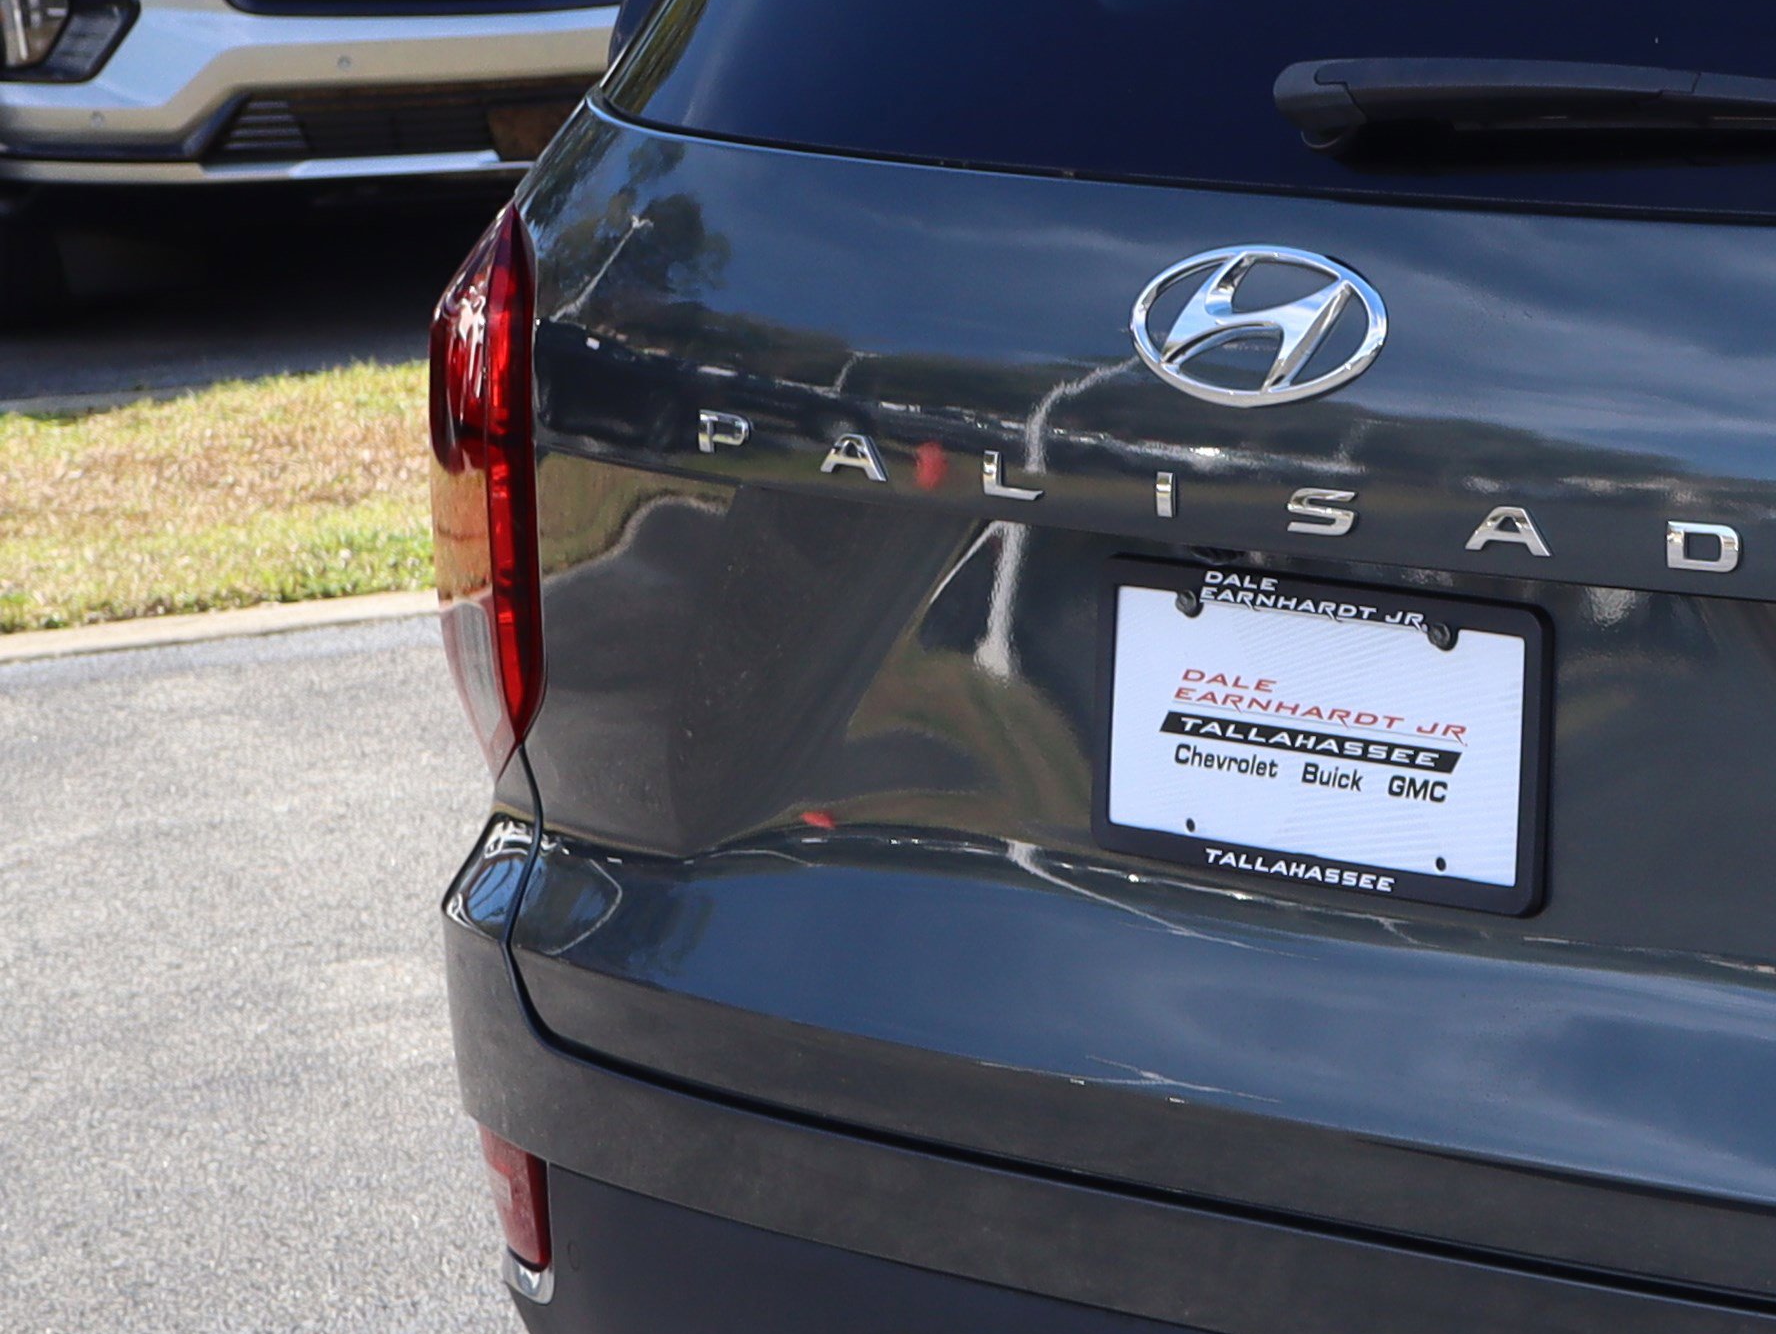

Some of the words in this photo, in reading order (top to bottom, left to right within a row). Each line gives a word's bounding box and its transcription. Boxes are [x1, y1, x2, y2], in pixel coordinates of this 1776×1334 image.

[1205, 570, 1278, 591] DALE
[1200, 586, 1377, 621] EARNHARDT
[1182, 669, 1277, 693] DALE
[1174, 687, 1404, 728] EARNHARDT
[1181, 717, 1439, 767] TALLAHASSEE
[1174, 744, 1279, 779] Chevrolet
[1301, 762, 1363, 792] Buick
[1388, 775, 1449, 803] GMC
[1205, 847, 1395, 893] TALLAHASSEE
